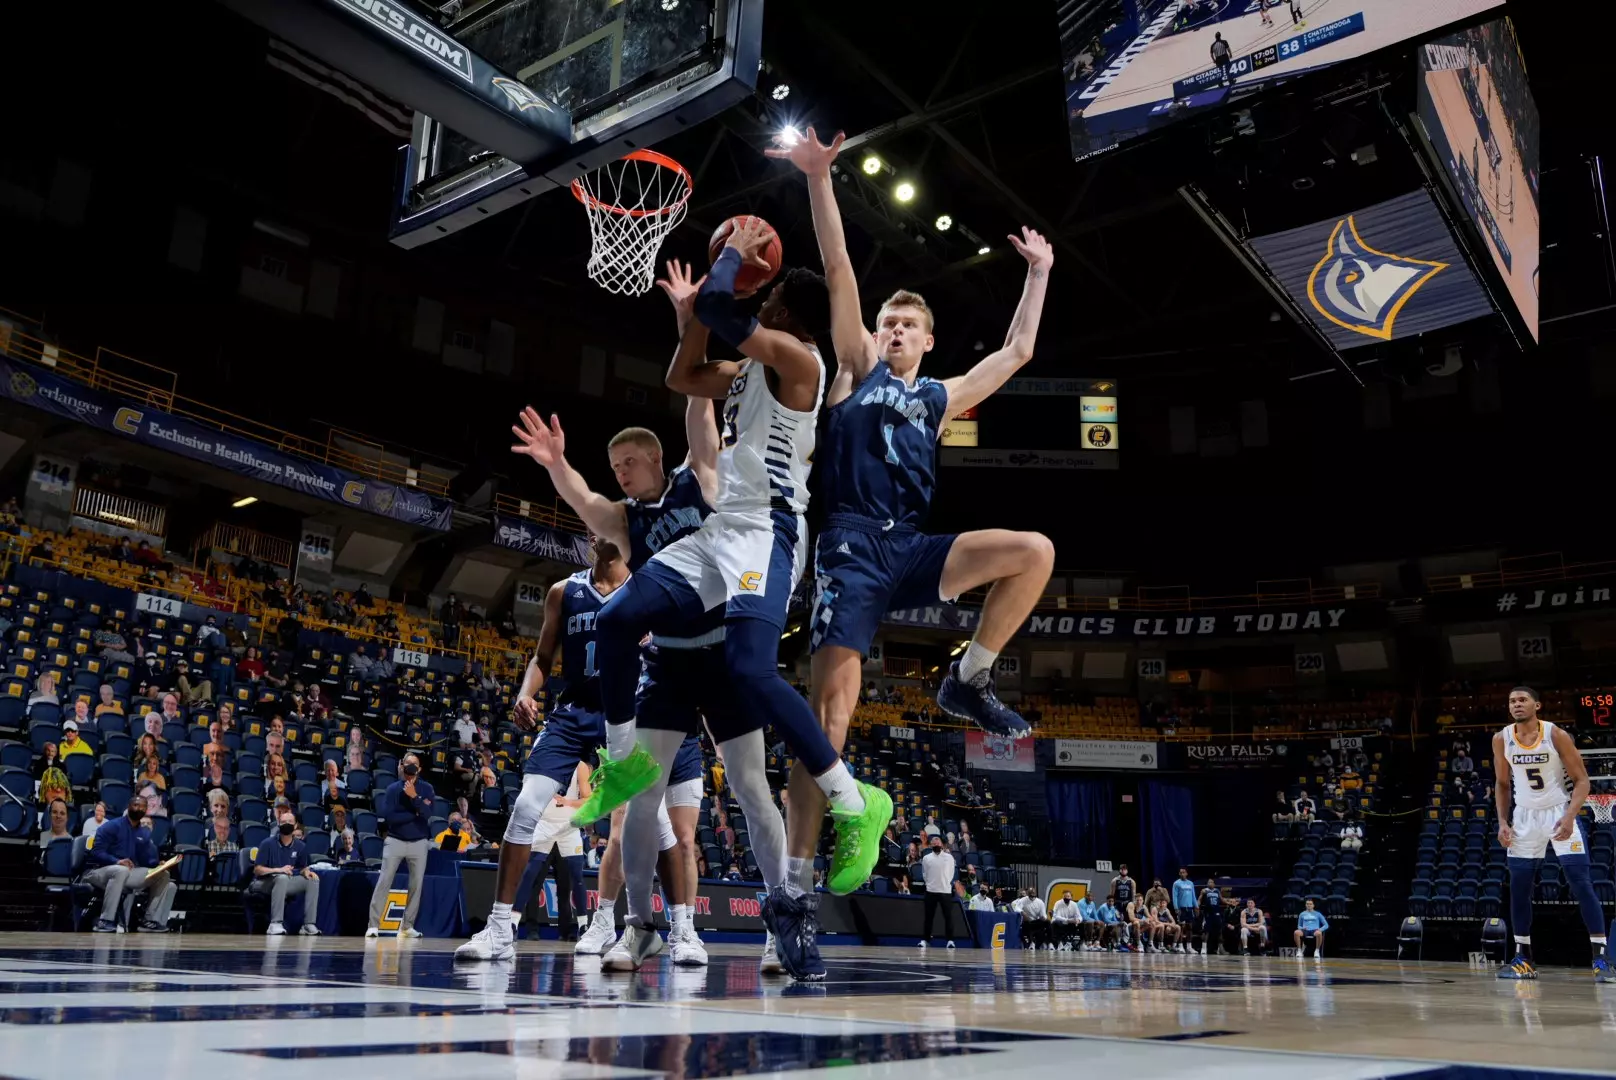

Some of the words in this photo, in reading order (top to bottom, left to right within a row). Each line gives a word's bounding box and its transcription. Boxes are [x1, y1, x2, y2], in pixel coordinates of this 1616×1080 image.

[352, 0, 464, 67] OCS.COM
[1307, 18, 1351, 39] CHATTANOOGA
[1253, 47, 1275, 60] 17:00
[1281, 40, 1299, 56] 38
[1229, 60, 1247, 74] 40
[1182, 77, 1195, 86] THE
[1195, 67, 1222, 81] CITADEL
[1075, 143, 1119, 162] DAKTRONICS
[38, 385, 103, 415] erlanger
[148, 421, 212, 453] Exclusive
[214, 442, 283, 475] Healthcare
[285, 464, 336, 493] Provider
[520, 584, 542, 602] 216
[145, 597, 173, 616] 114
[1029, 615, 1116, 635] MOCS
[1133, 615, 1217, 636] CLUB
[1232, 608, 1346, 633] TODAY
[1521, 639, 1547, 654] 221
[399, 649, 422, 665] 115
[1299, 655, 1322, 669] 220
[1580, 694, 1614, 707] 16:58
[1592, 707, 1610, 726] 12
[895, 728, 911, 737] 117
[1187, 745, 1227, 760] RUBY
[1231, 744, 1274, 756] FALLS
[1336, 739, 1357, 748] 120
[1513, 754, 1548, 764] MOCS
[1525, 768, 1545, 790] 5
[1098, 862, 1110, 870] 117
[729, 897, 761, 917] FOOD
